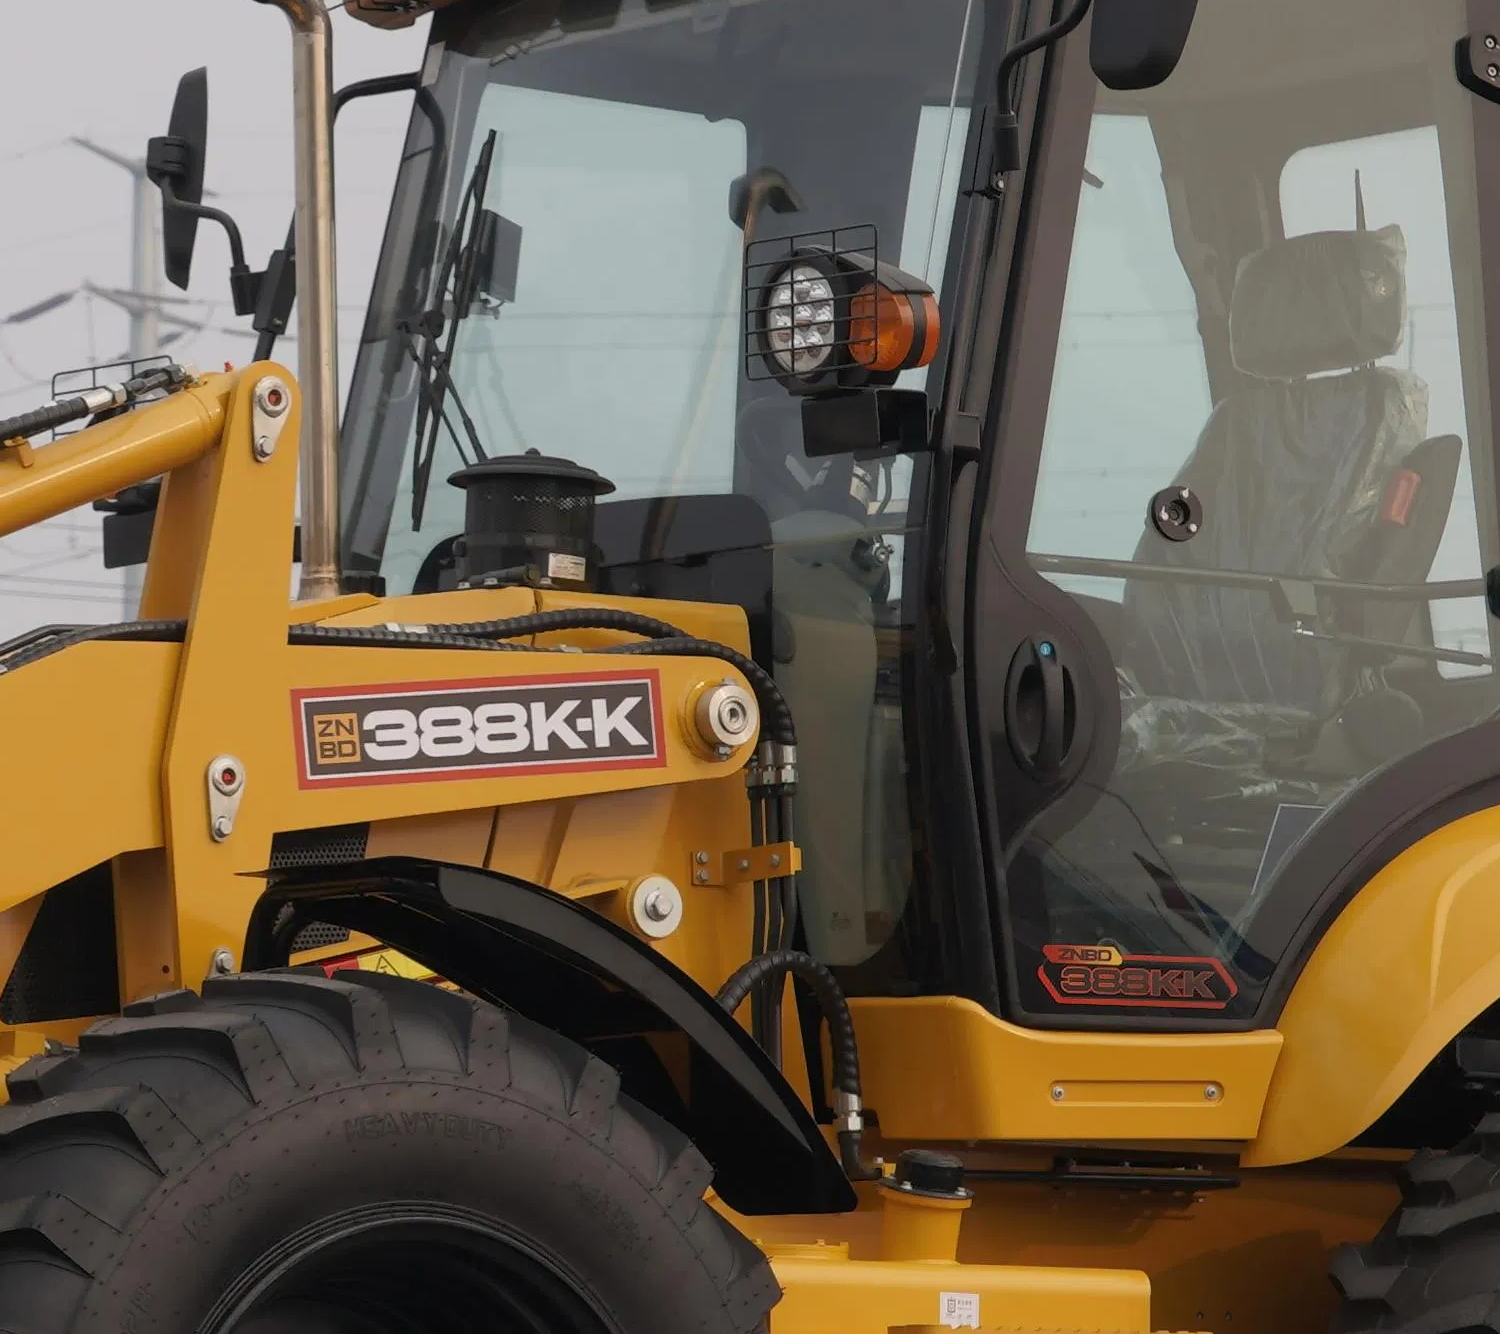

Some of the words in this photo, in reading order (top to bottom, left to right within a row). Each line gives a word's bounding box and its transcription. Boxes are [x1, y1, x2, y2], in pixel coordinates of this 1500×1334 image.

[317, 718, 355, 737] ZN
[362, 695, 649, 762] 388K-K
[319, 740, 358, 759] BD
[1058, 948, 1112, 962] ZNBD
[343, 1111, 438, 1144] HEAVY
